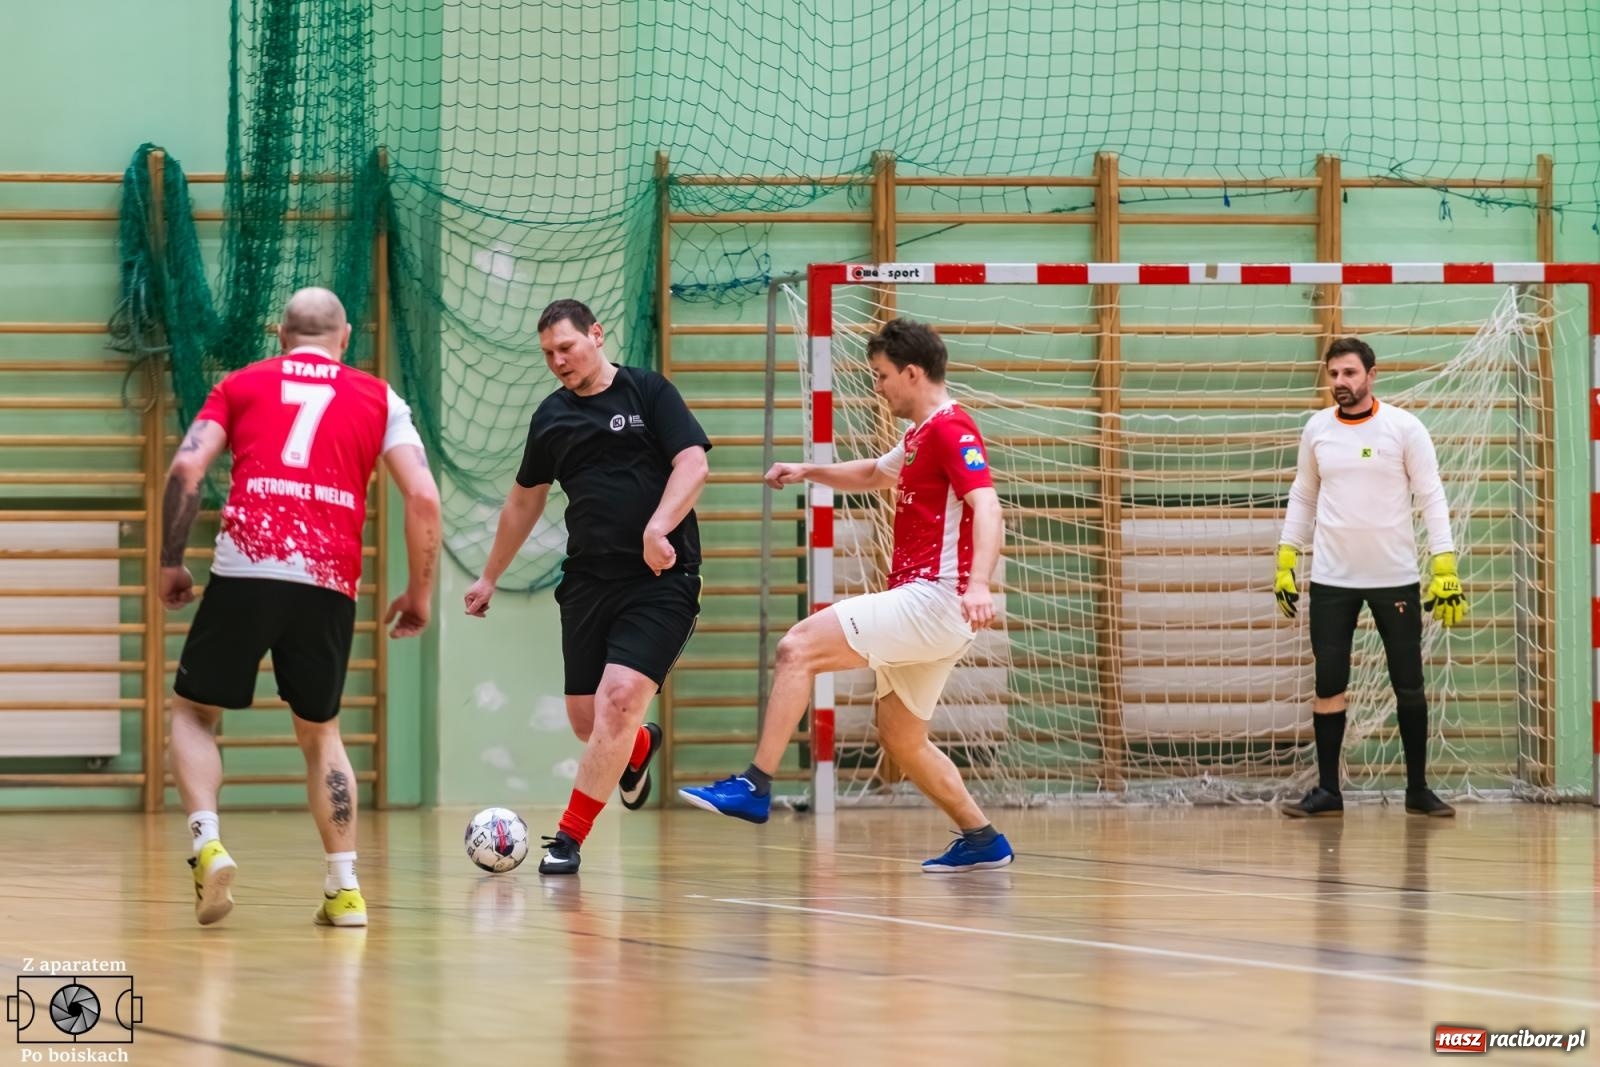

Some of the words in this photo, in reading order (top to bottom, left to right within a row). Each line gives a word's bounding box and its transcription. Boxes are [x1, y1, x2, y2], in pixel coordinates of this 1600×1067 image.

[888, 268, 920, 280] sport
[281, 360, 341, 379] START
[280, 379, 336, 469] 7
